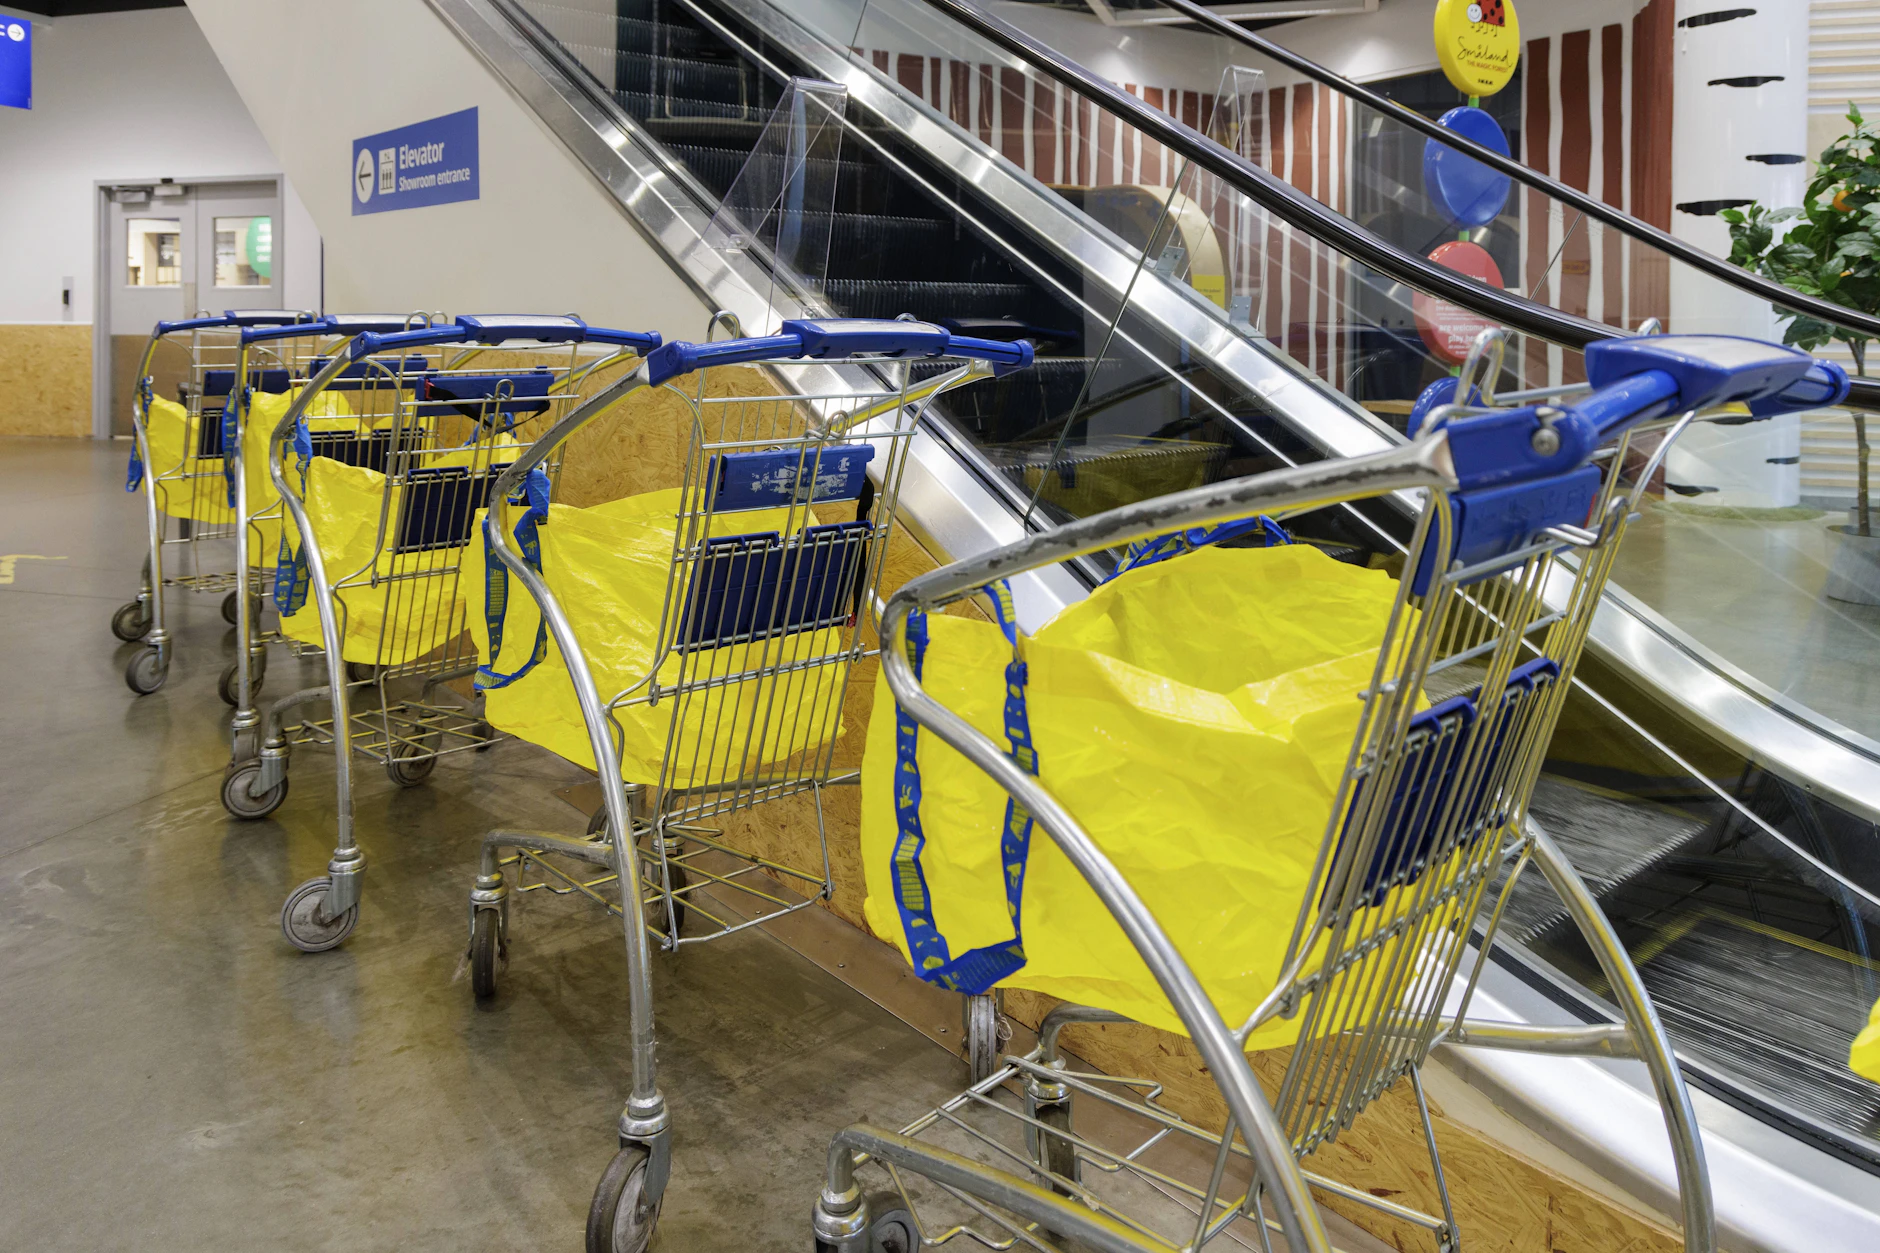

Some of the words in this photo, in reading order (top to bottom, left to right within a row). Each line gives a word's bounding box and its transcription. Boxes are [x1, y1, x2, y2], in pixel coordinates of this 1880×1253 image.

[1458, 36, 1513, 68] Småland
[399, 143, 445, 169] Elevator
[399, 174, 436, 191] Showroom
[437, 168, 471, 185] entrance
[1439, 324, 1451, 332] are
[1452, 323, 1484, 331] welcome
[1448, 334, 1463, 344] play
